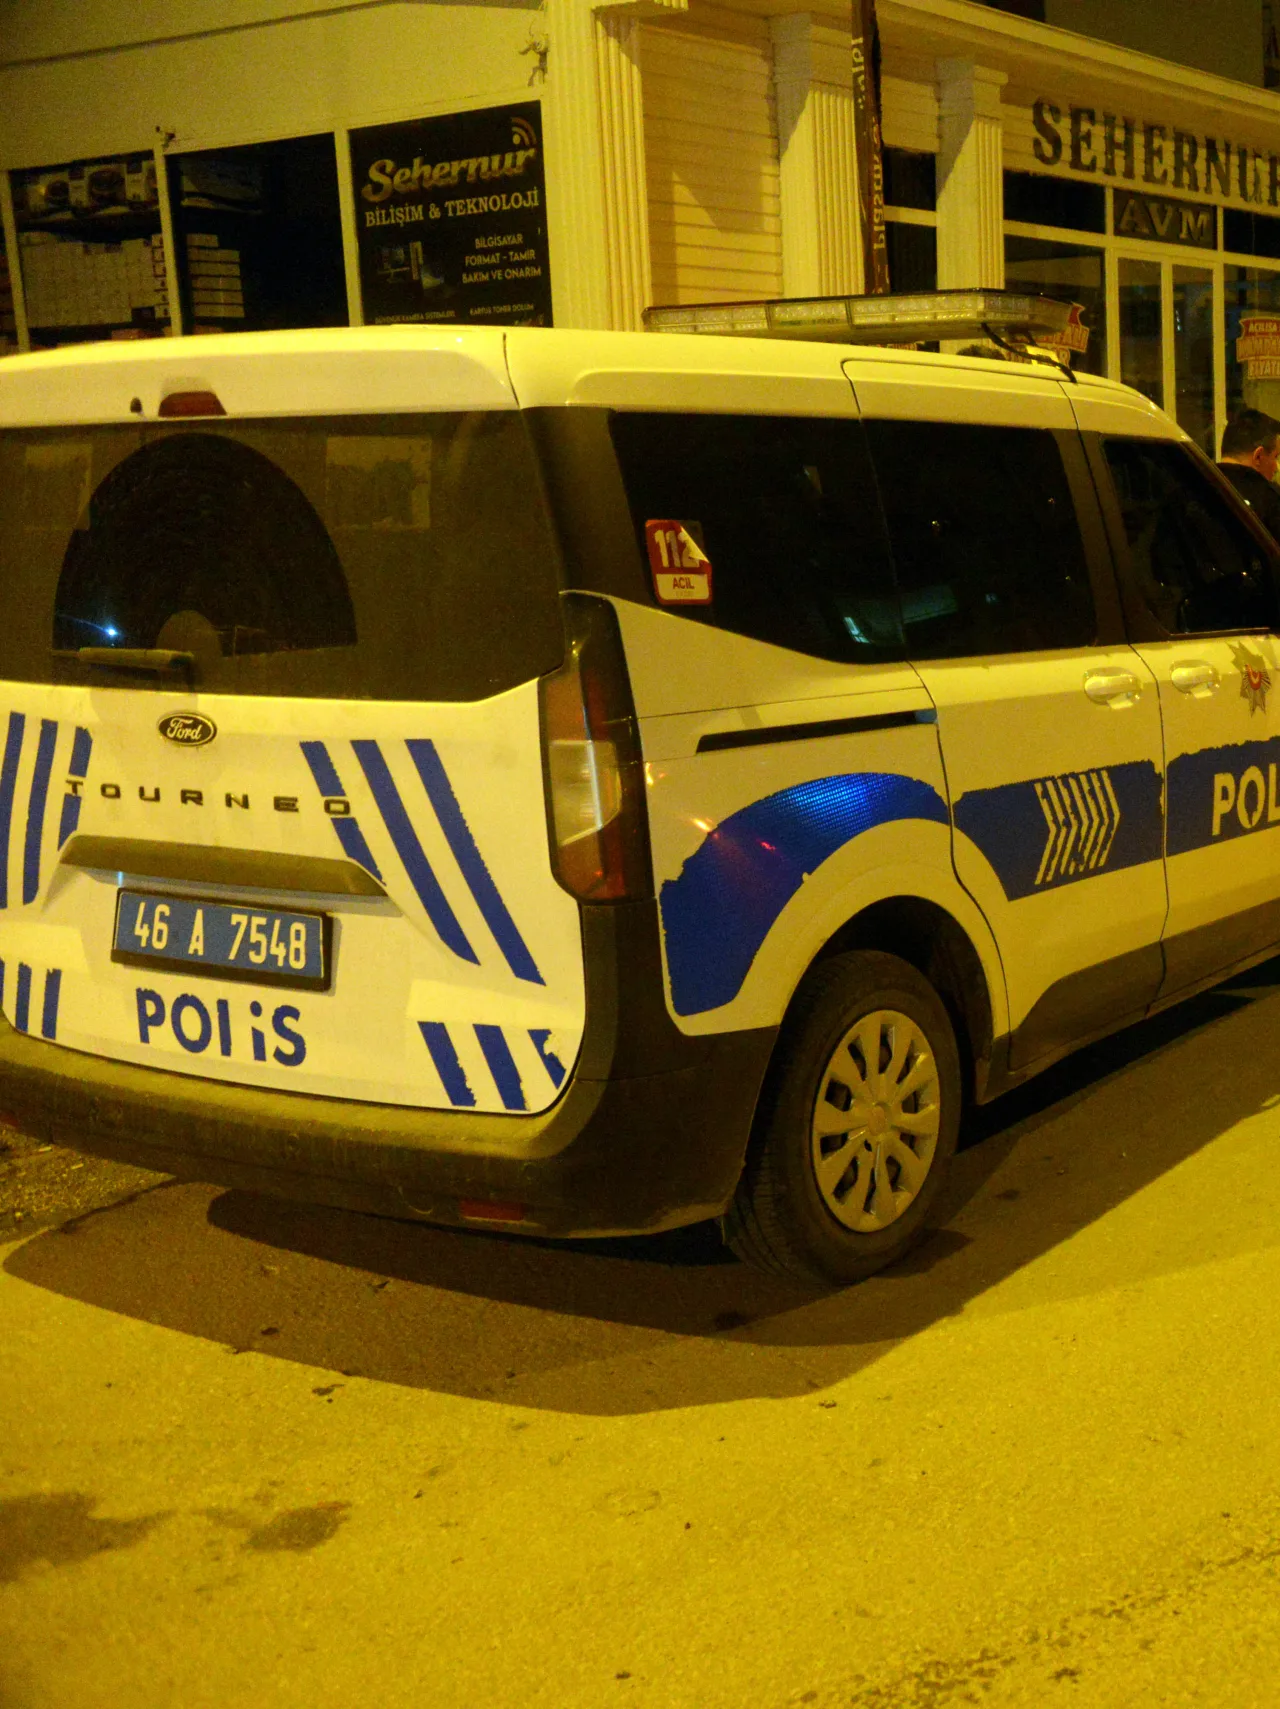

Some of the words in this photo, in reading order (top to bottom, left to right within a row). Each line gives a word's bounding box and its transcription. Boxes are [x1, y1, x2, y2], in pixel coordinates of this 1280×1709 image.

[361, 147, 537, 203] Sehernur
[365, 203, 423, 227] BİLİŞİM
[428, 204, 442, 220] &
[445, 187, 539, 217] TEKNOLOJİ
[1117, 197, 1212, 242] AVM
[464, 254, 500, 268] FORMAT
[509, 248, 537, 262] TAMİR
[474, 232, 524, 250] BİLGİSAYAR
[166, 717, 203, 741] Ford
[65, 778, 352, 816] TOURNEO
[133, 901, 171, 951] 46
[187, 908, 205, 957] A
[228, 913, 307, 971] 7548
